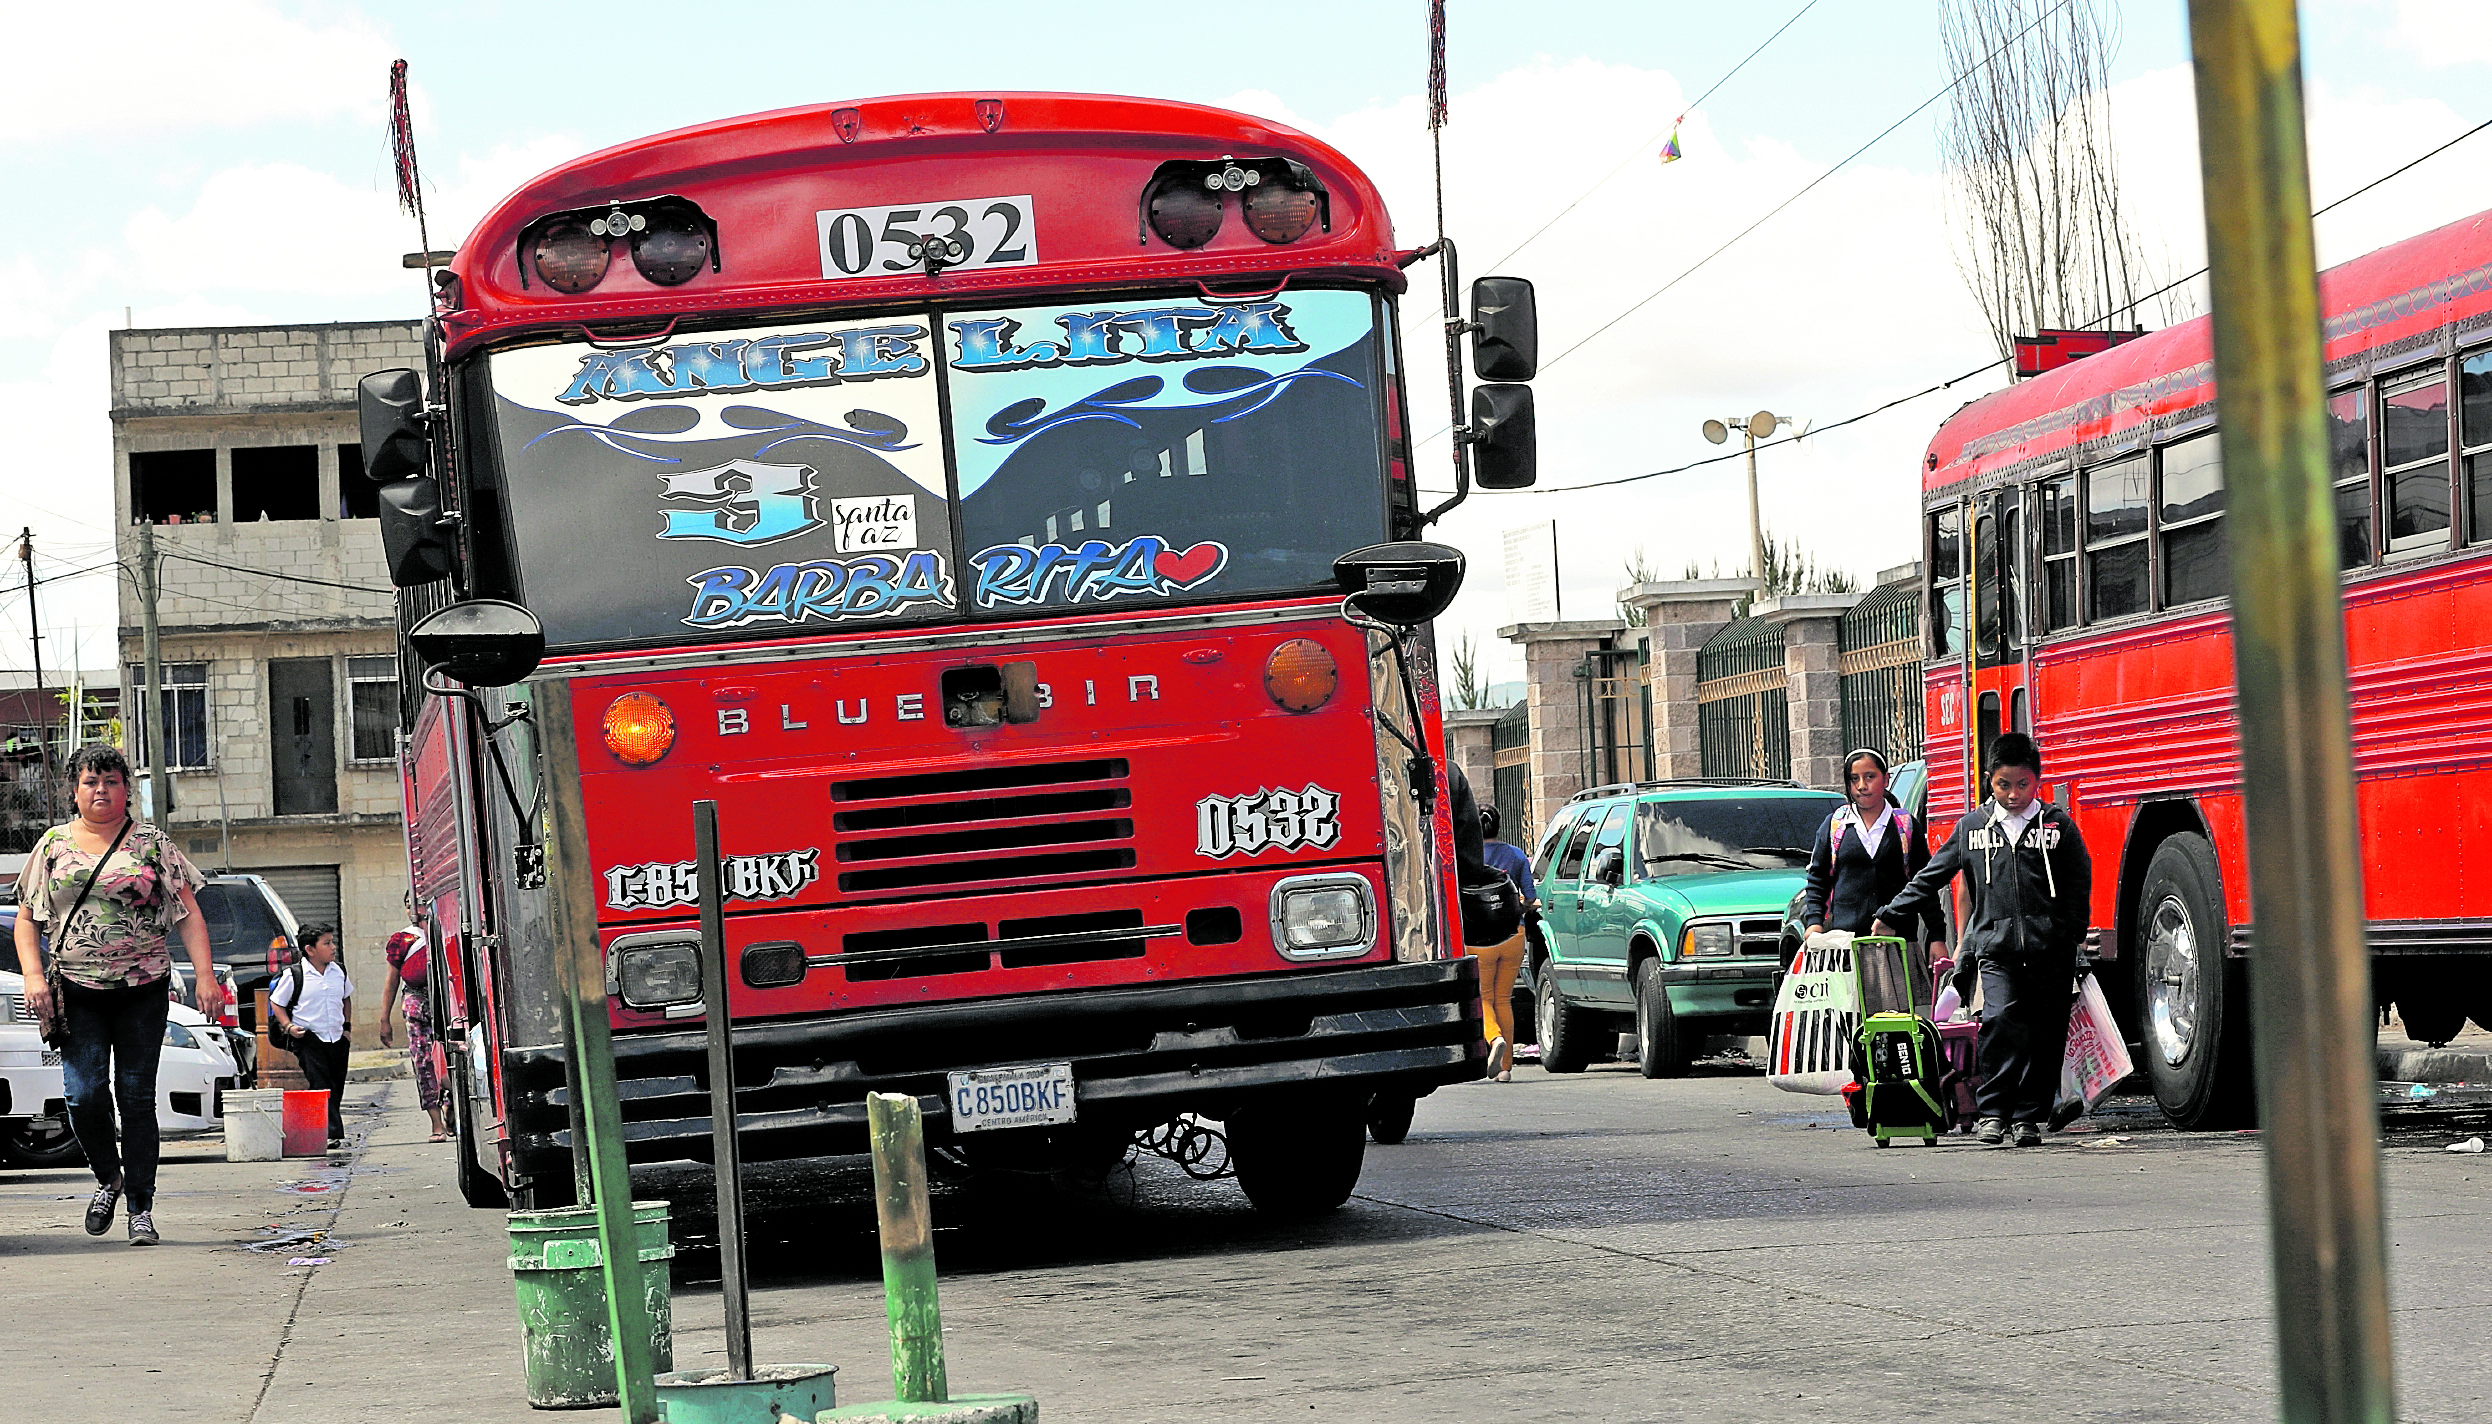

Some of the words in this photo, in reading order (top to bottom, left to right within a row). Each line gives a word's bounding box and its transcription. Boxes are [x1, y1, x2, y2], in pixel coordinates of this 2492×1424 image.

[828, 202, 1028, 275] 0532
[656, 459, 828, 548] 3
[681, 550, 957, 628] BARBA
[969, 535, 1170, 608] RITA
[717, 693, 925, 736] BLUE
[1940, 692, 1955, 726] SEC
[1195, 783, 1343, 859] 0532
[603, 848, 820, 912] C-85BKF
[981, 1116, 1012, 1127] CENTRO
